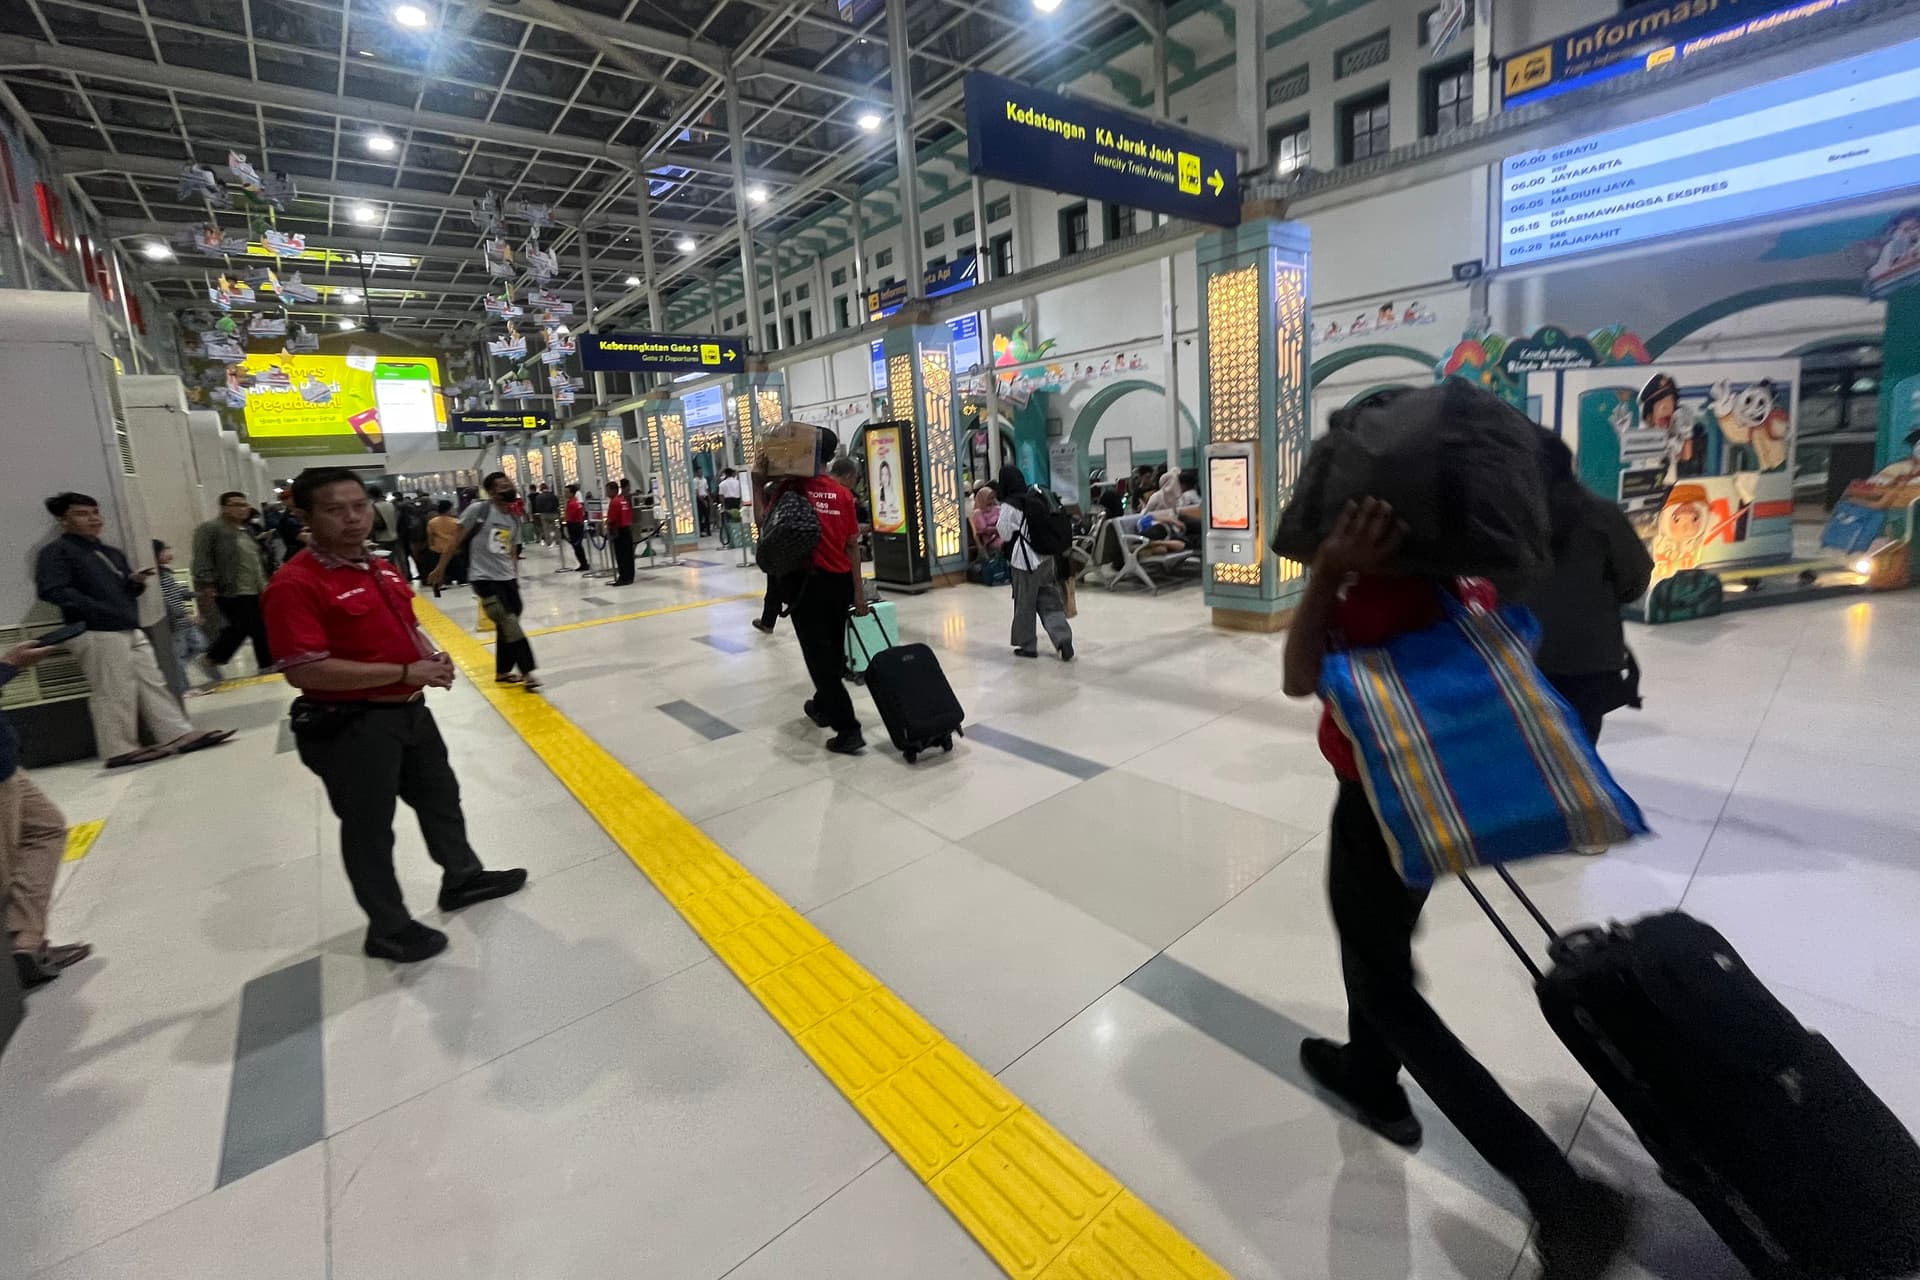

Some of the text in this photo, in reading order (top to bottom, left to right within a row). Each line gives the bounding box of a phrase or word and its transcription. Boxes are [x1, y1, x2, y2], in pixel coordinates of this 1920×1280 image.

[1006, 101, 1174, 165] Kedatangan KA Jarak Jauh
[1093, 151, 1127, 173] Intercity
[1127, 160, 1147, 177] Train
[1511, 154, 1546, 170] 06.00
[1552, 141, 1598, 161] SERAYU
[1511, 177, 1545, 192] 06.00
[1551, 158, 1623, 183] JAYAKARTA
[1550, 186, 1601, 207] MADIUN
[1603, 178, 1636, 193] JAYA
[1550, 196, 1664, 228] DHARMAWANGSA
[1666, 180, 1729, 203] EKSPRES
[1549, 228, 1622, 250] MAJAPAHIT
[599, 341, 669, 353] Keberangkatan
[670, 344, 692, 353] Gate
